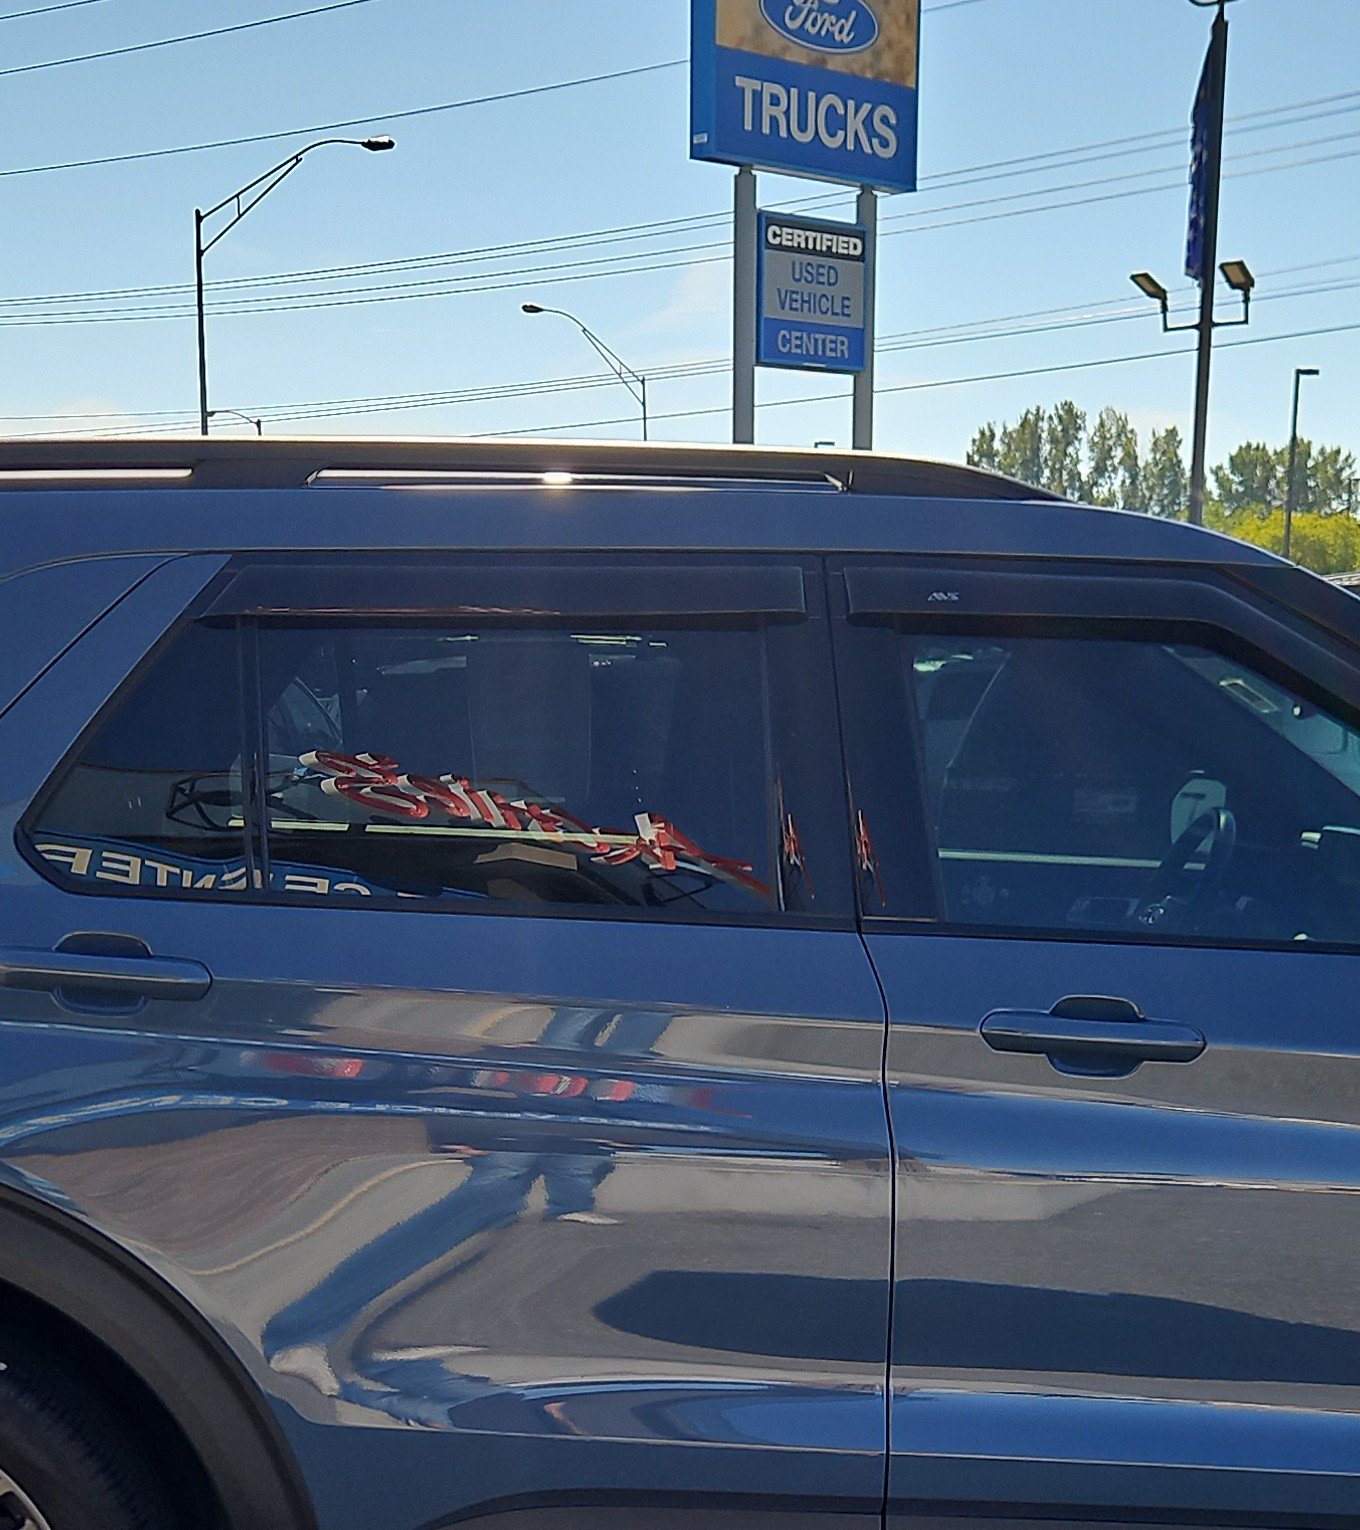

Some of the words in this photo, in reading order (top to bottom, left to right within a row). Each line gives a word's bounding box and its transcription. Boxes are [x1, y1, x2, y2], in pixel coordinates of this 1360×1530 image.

[784, 0, 857, 44] Ford
[735, 75, 898, 159] TRUCKS
[766, 225, 864, 256] CERTIFIED
[791, 260, 839, 287] USED
[776, 287, 852, 317] VEHICLE
[777, 329, 849, 359] CENTER
